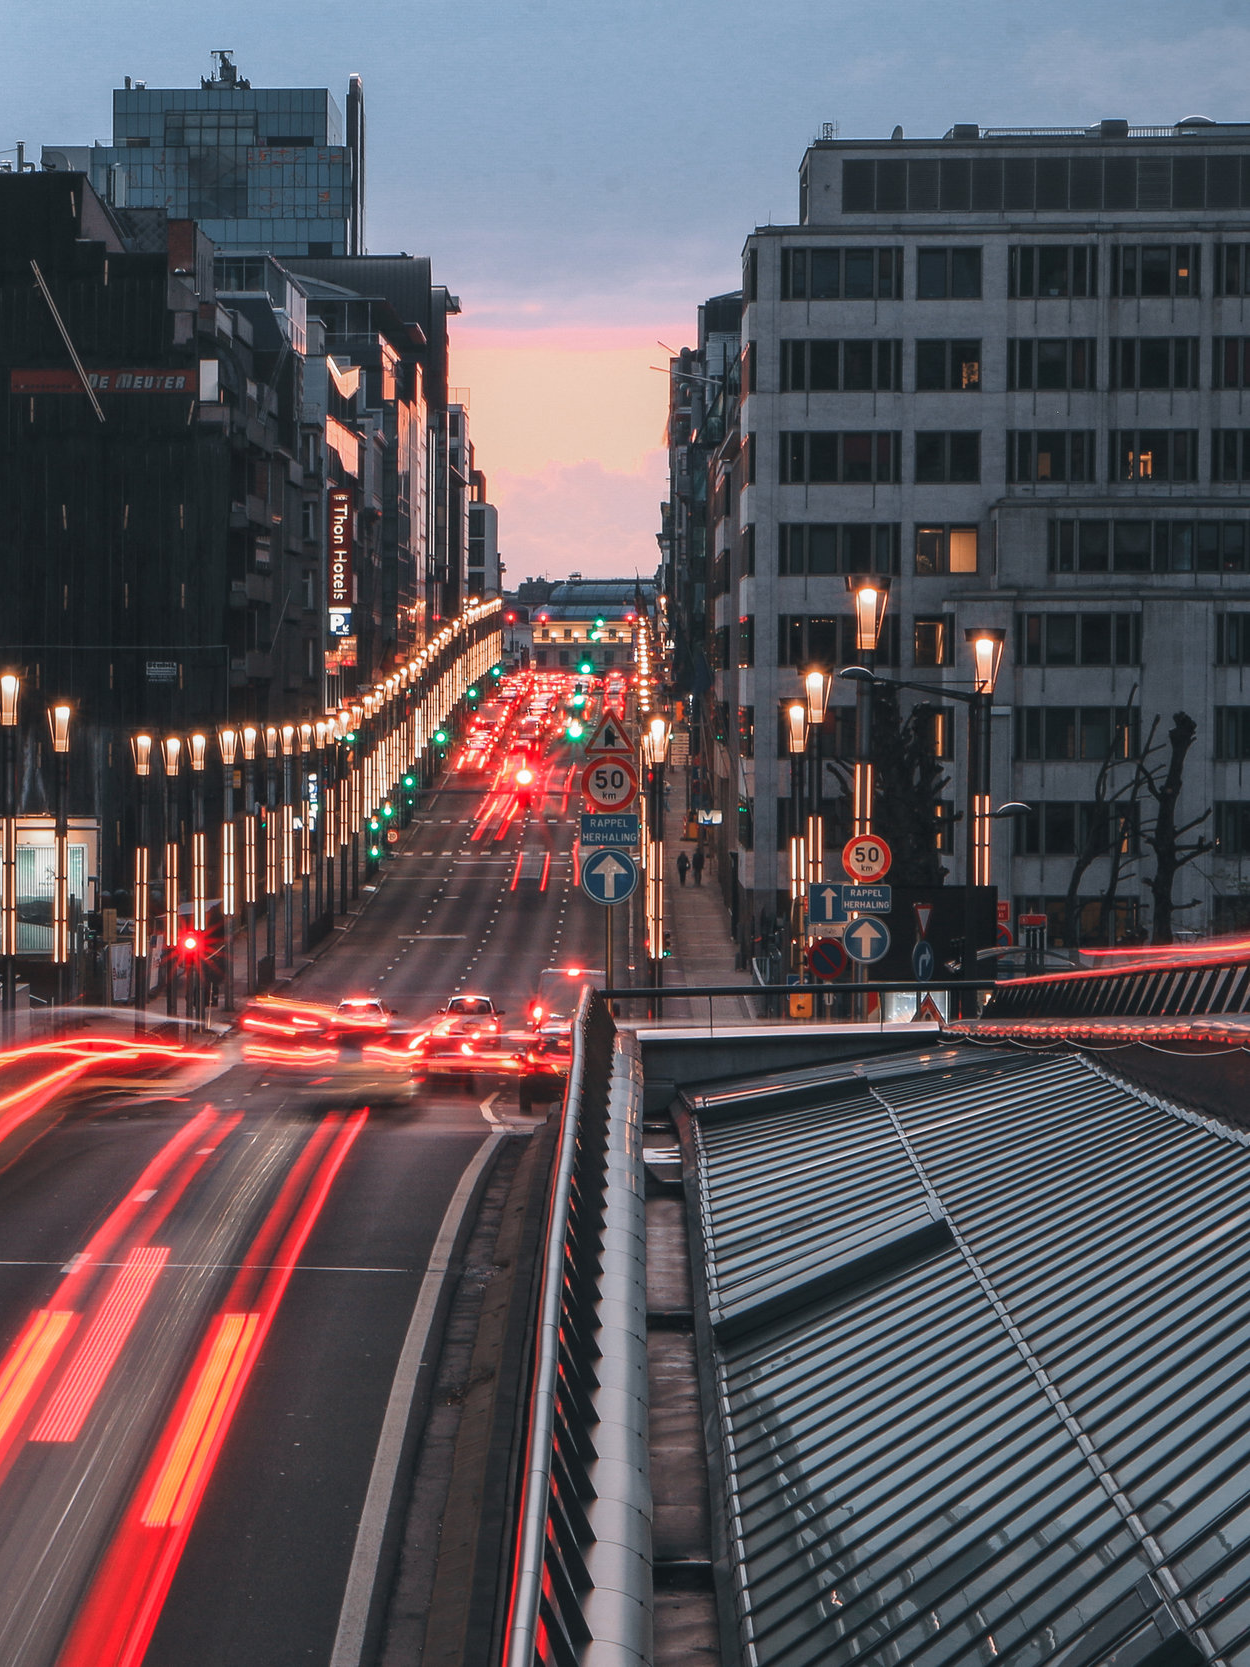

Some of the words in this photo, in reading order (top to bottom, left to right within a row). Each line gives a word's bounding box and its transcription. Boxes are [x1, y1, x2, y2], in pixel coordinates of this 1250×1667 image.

[115, 373, 186, 389] MEUTER
[333, 504, 348, 544] Thon
[333, 550, 348, 600] Hotels
[330, 614, 345, 632] P
[595, 770, 624, 789] 50
[602, 791, 617, 800] km
[590, 818, 628, 828] RAPPEL
[698, 810, 723, 824] M
[583, 833, 637, 842] HERHALING
[855, 847, 879, 863] 50
[850, 889, 882, 897] RAPPEL
[844, 901, 890, 909] HERHALING
